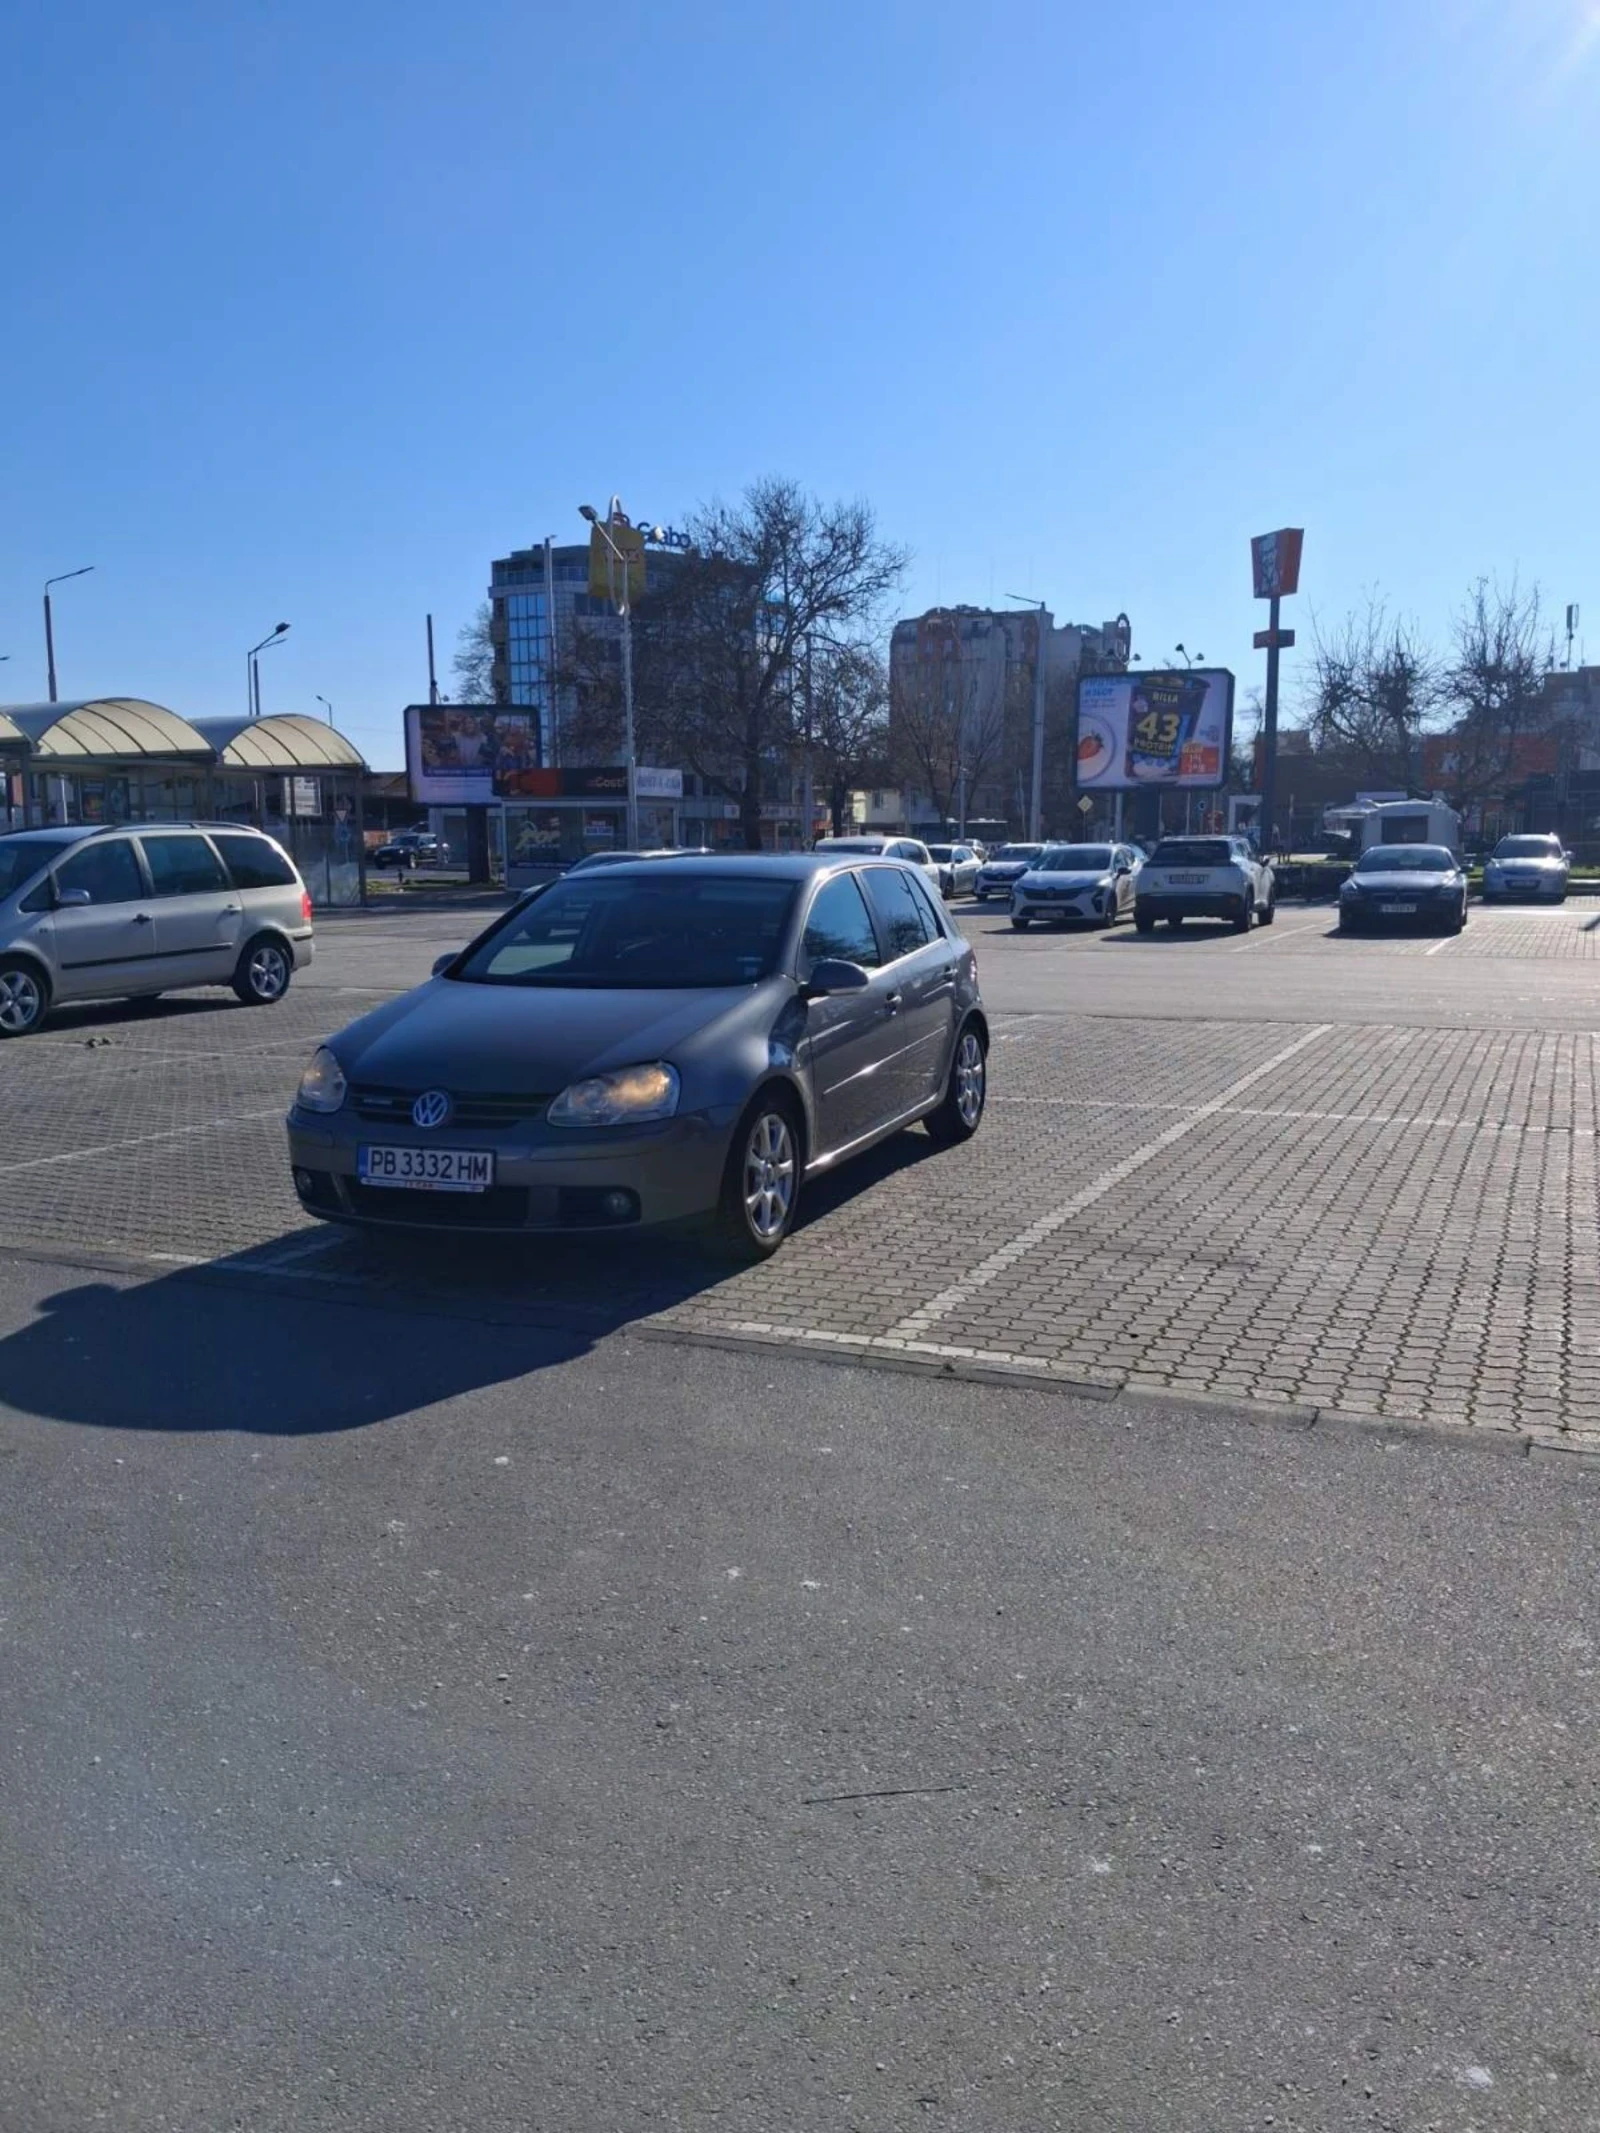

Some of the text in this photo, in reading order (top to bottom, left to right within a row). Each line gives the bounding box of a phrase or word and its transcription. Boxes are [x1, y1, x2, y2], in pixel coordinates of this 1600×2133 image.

[1152, 691, 1179, 704] BILLA
[1136, 711, 1180, 742] 43
[1133, 737, 1175, 752] PROTEIN
